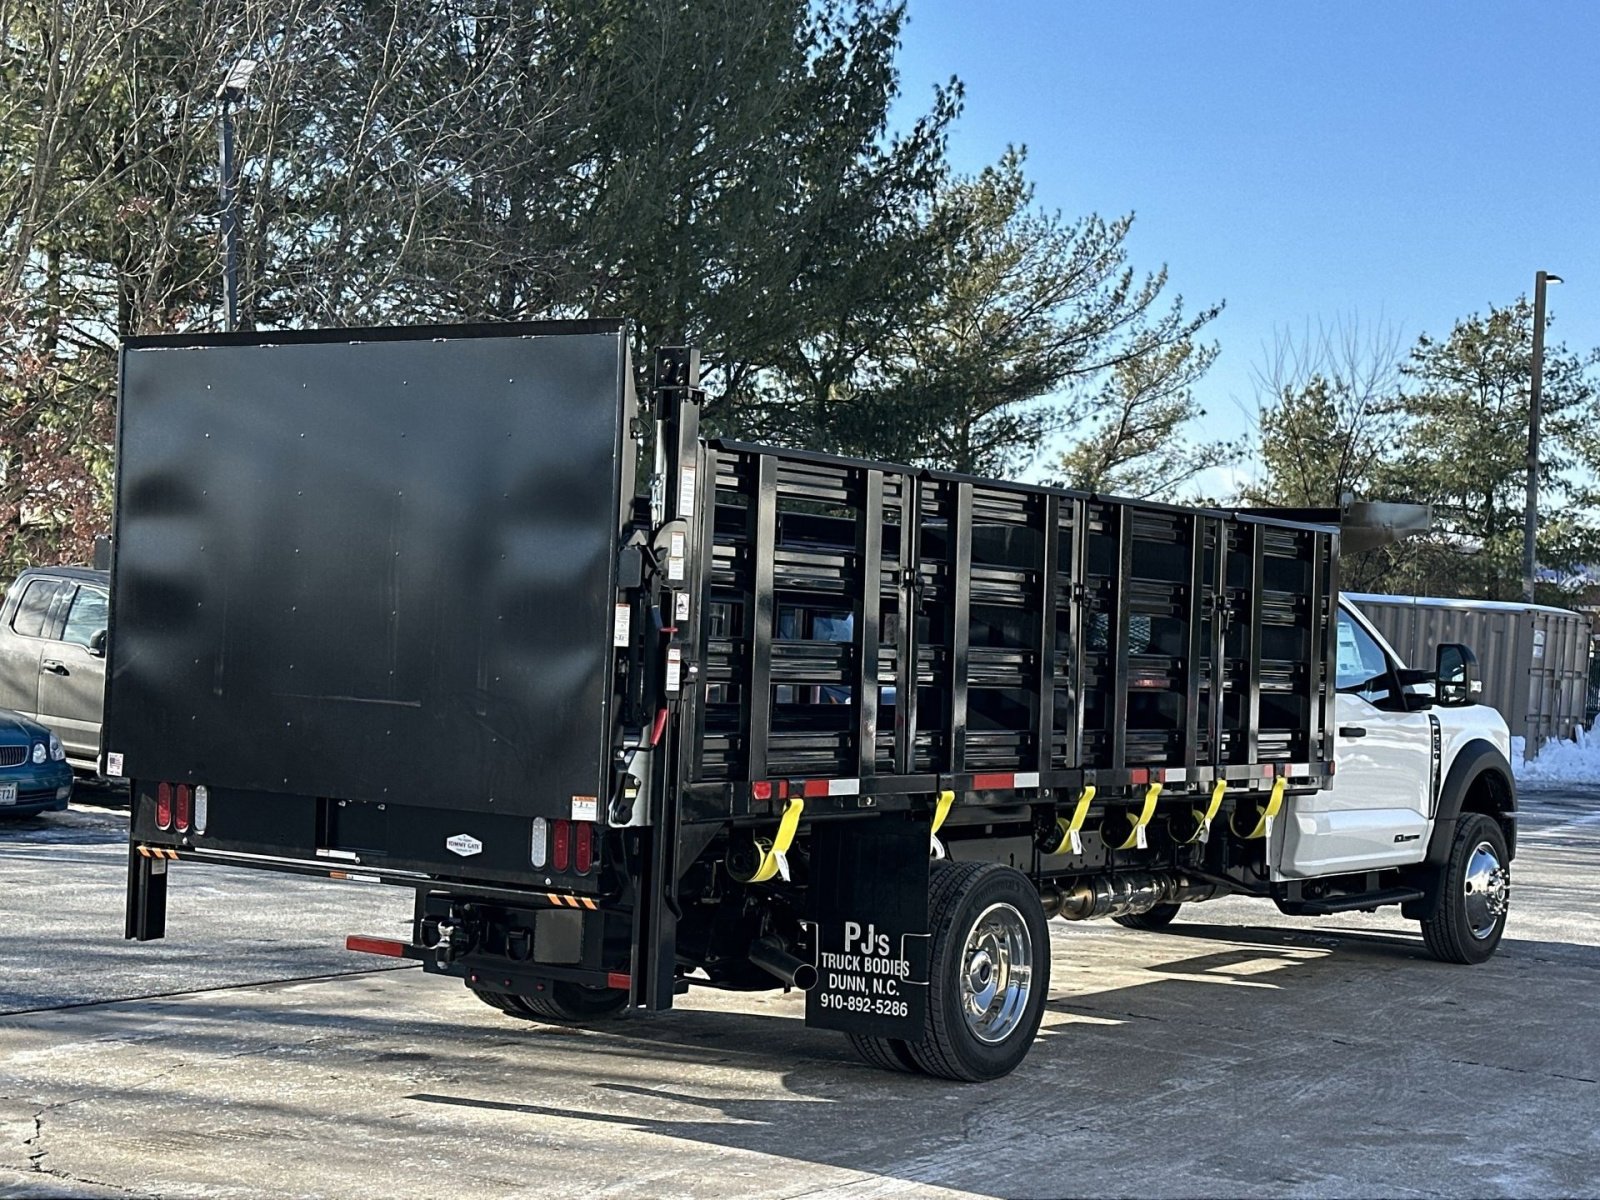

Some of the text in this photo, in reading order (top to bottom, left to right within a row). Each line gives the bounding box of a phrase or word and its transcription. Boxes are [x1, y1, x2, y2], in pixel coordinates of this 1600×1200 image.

[821, 952, 910, 977] TRUCK BODIES
[829, 973, 900, 996] DUNN, N.C.
[820, 993, 908, 1017] 910-892-5286
